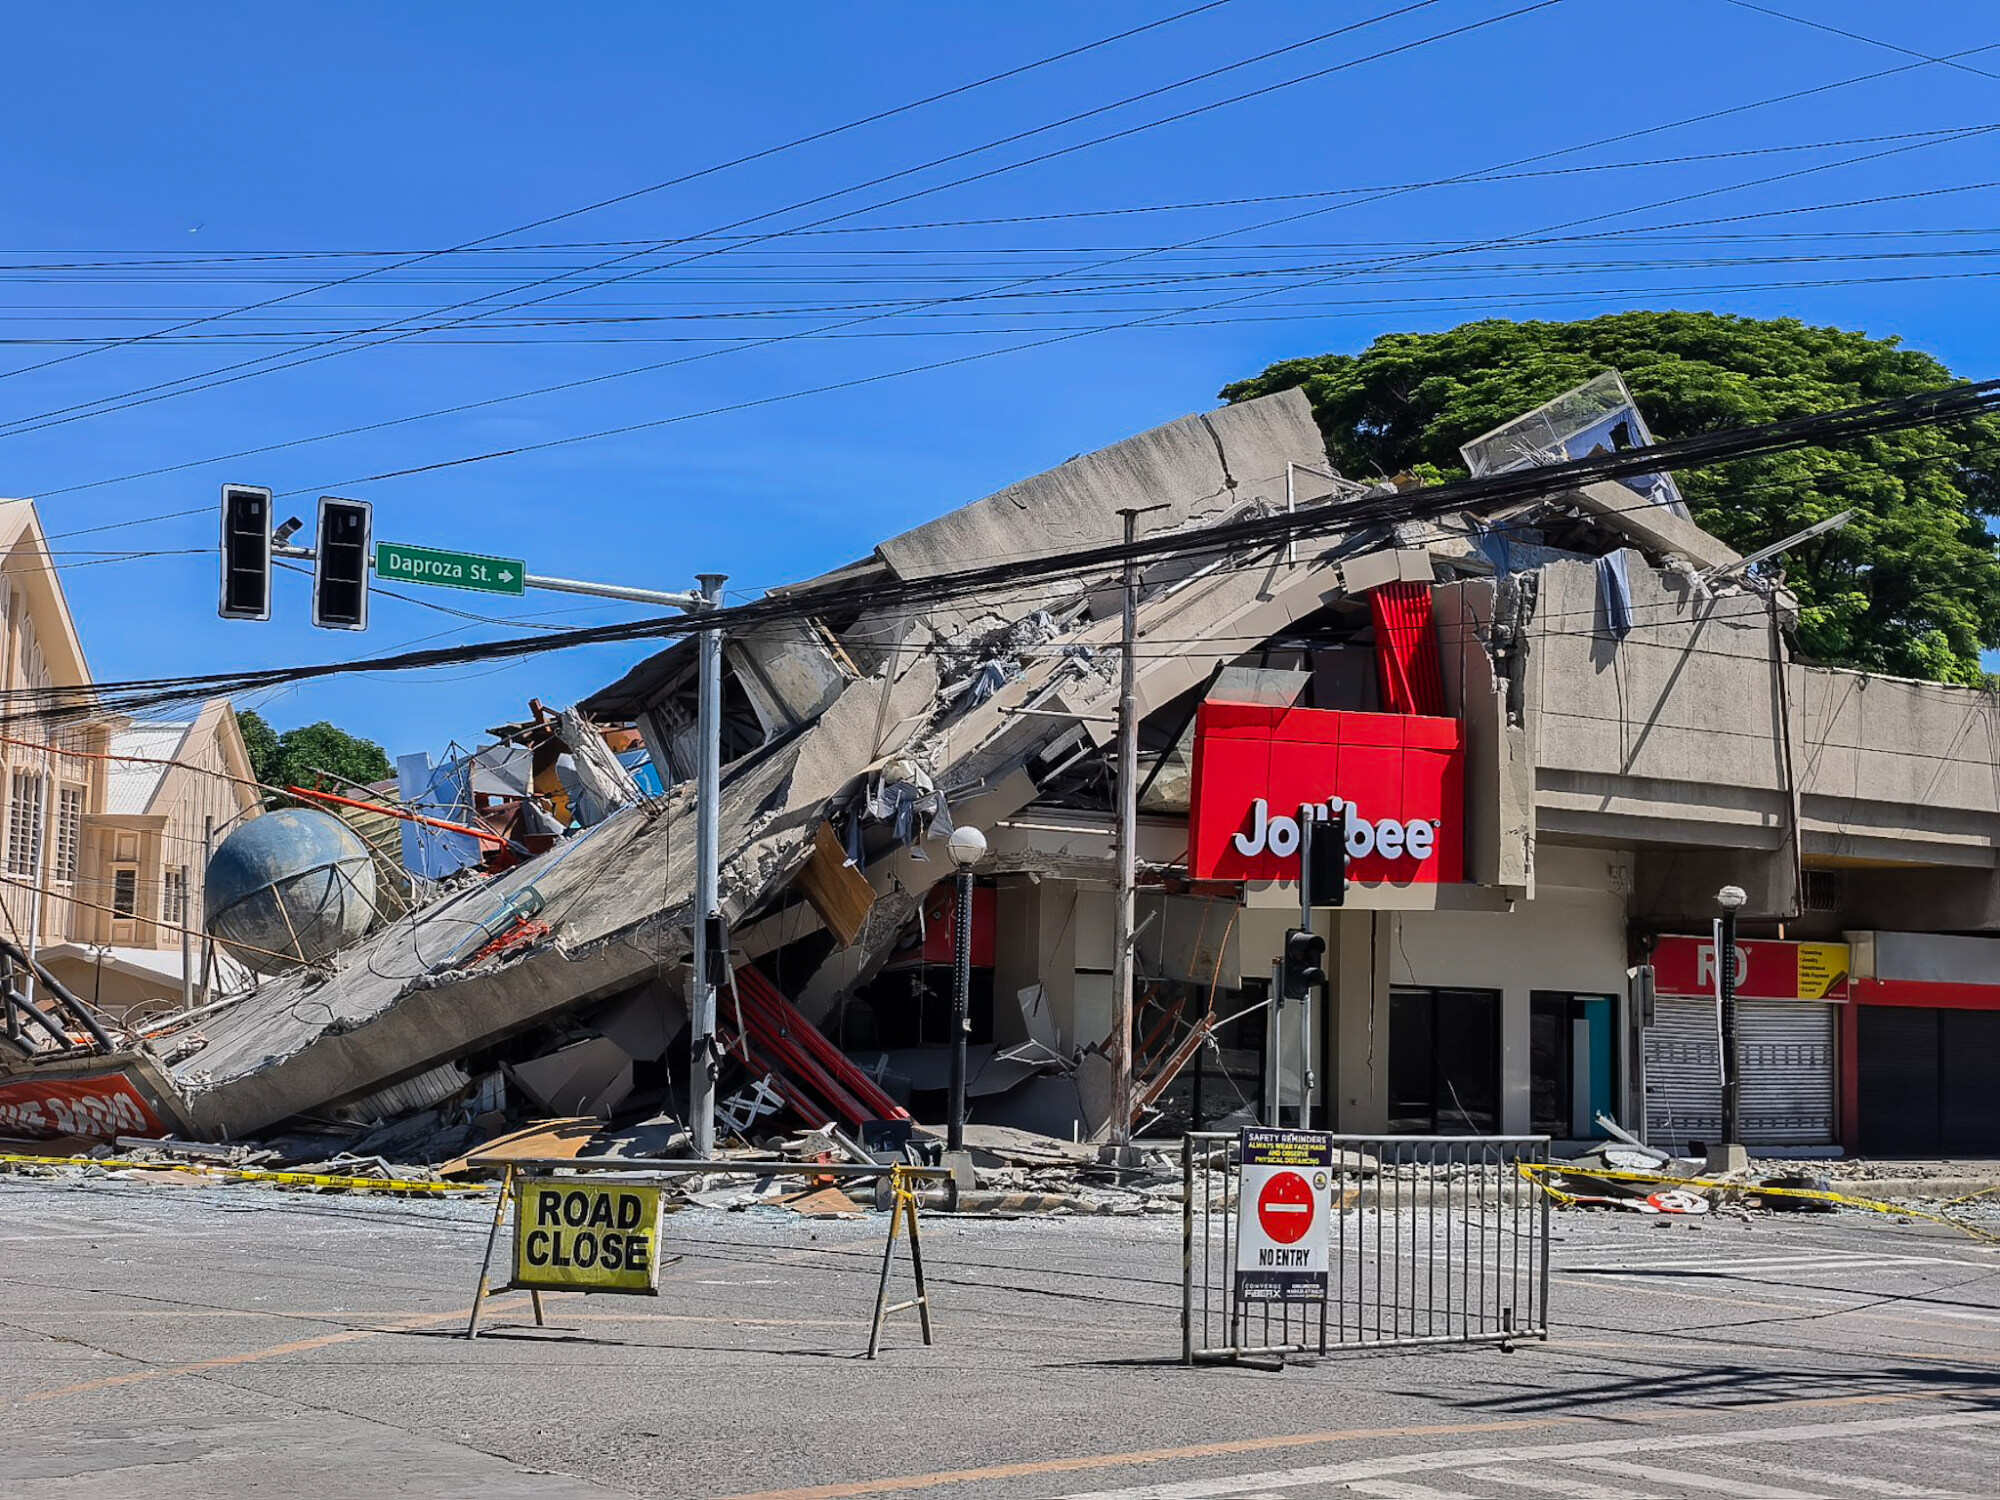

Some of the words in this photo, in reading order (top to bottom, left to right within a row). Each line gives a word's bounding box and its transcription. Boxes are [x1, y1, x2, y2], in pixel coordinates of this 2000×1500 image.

[389, 553, 462, 578] Daproza
[470, 564, 492, 582] St.
[1232, 795, 1435, 860] Jobee
[1248, 1132, 1280, 1143] SAFETY
[1281, 1133, 1327, 1144] REMINDERS
[1294, 1143, 1309, 1151] FACE
[1281, 1150, 1309, 1158] OBSERVE
[537, 1190, 641, 1229] ROAD
[526, 1230, 649, 1271] CLOSE
[1259, 1249, 1274, 1266] NO
[1275, 1249, 1310, 1267] ENTRY
